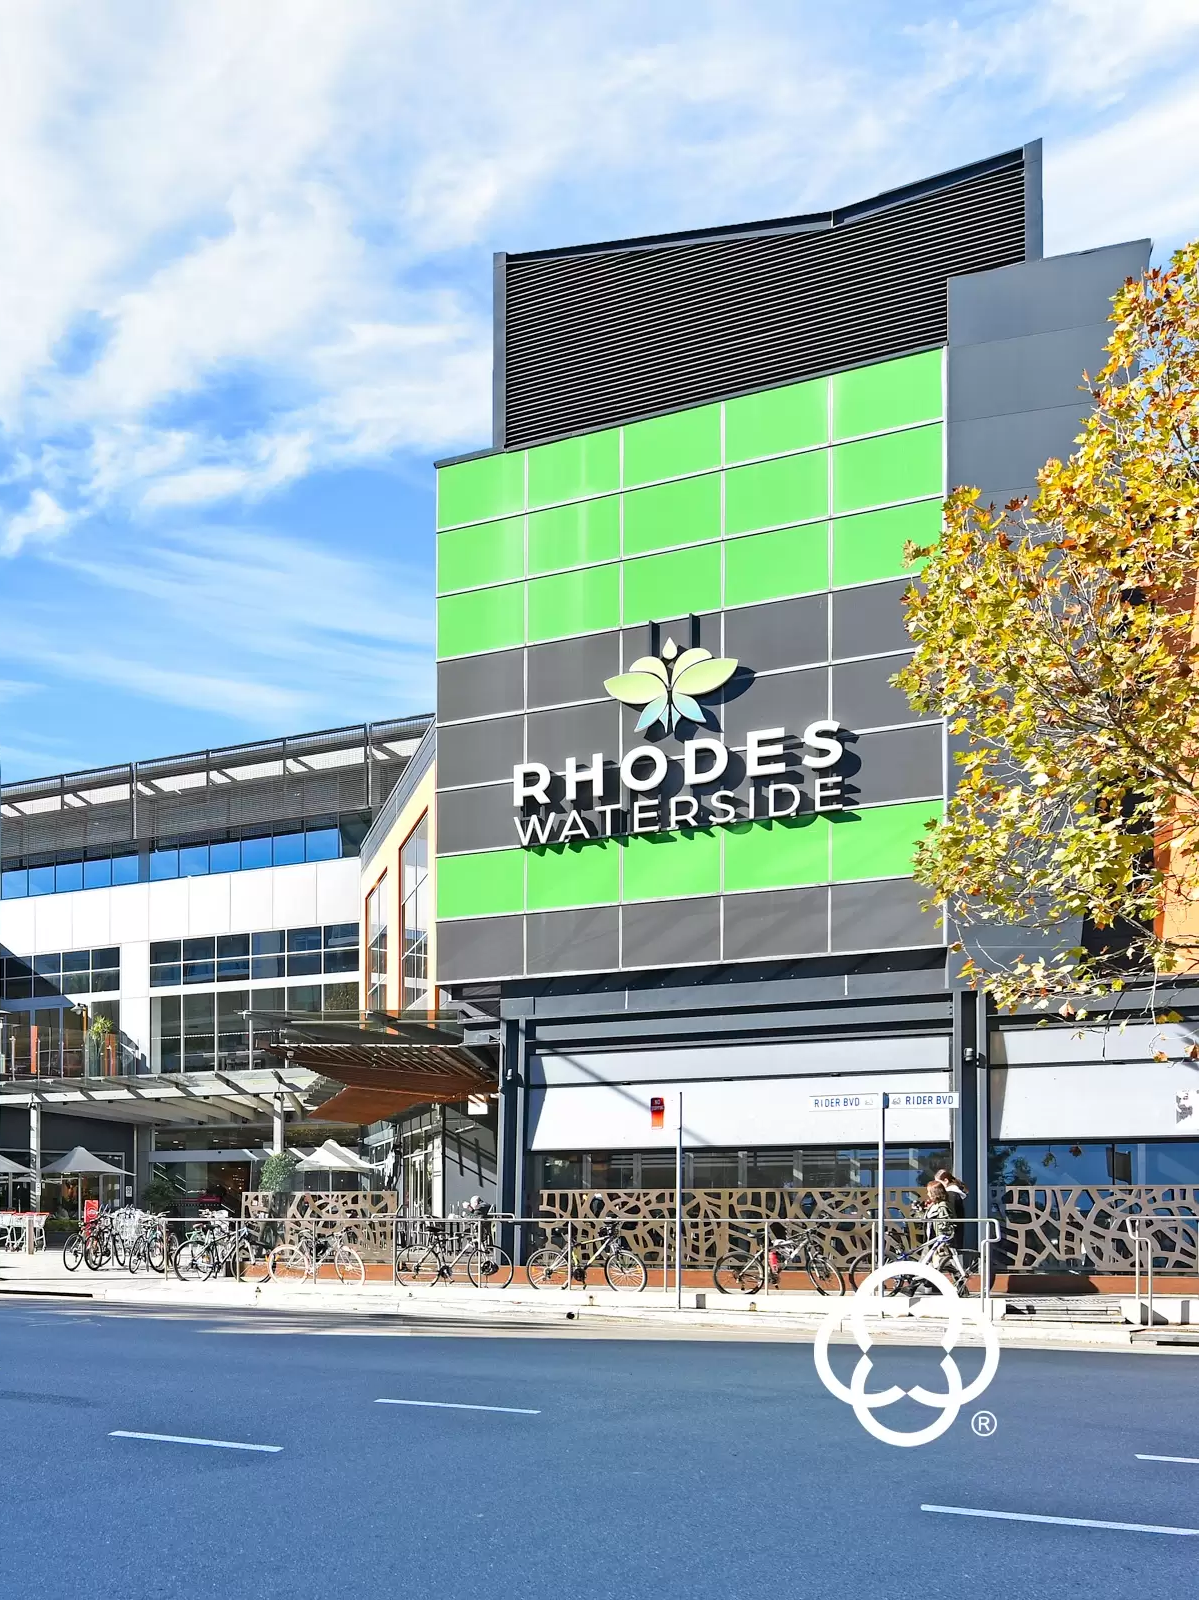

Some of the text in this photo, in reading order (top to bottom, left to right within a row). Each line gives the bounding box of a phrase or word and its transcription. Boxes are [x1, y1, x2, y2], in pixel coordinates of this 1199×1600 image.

[513, 720, 843, 807] RHODES
[514, 776, 843, 846] WATERSIDE
[814, 1097, 860, 1108] RIDER BVD
[905, 1095, 954, 1105] RIDER BVD
